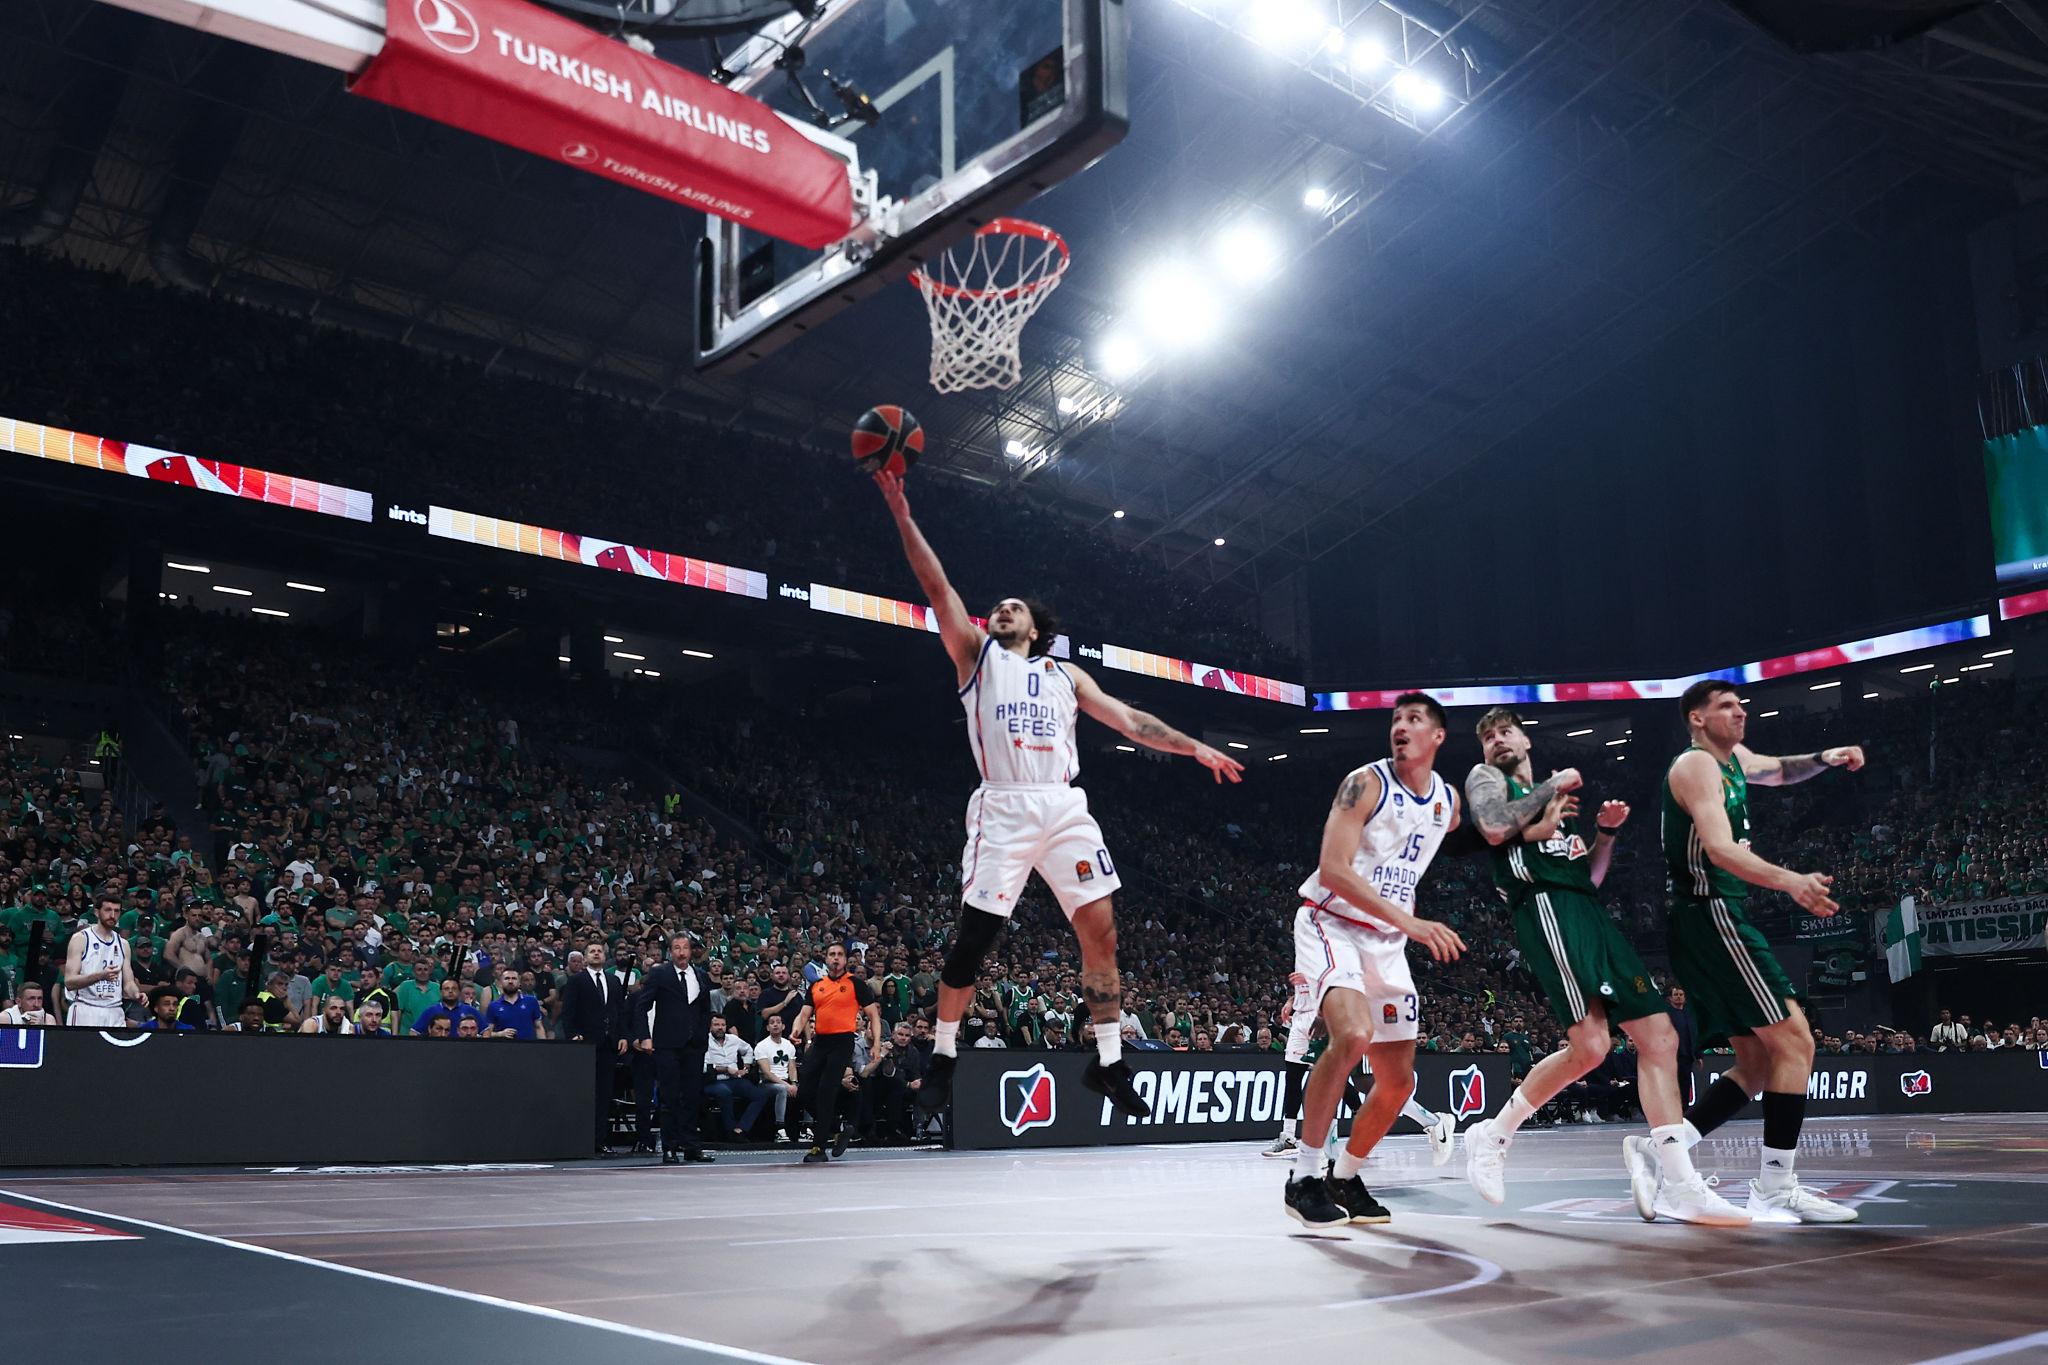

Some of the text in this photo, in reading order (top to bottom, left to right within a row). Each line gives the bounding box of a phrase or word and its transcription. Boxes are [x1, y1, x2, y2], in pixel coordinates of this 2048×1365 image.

[491, 28, 772, 154] TURKISH AIRLINES
[602, 157, 754, 220] TURKISH AIRLINES
[1028, 673, 1039, 697] 0
[996, 702, 1057, 721] ANADOL
[1009, 718, 1055, 737] EFES
[1096, 849, 1113, 876] 0
[1372, 866, 1417, 886] ANADO
[1380, 883, 1414, 903] EFE
[1925, 906, 1967, 920] EMPIRE
[1972, 902, 2021, 916] STRIKES
[1404, 994, 1416, 1021] 3
